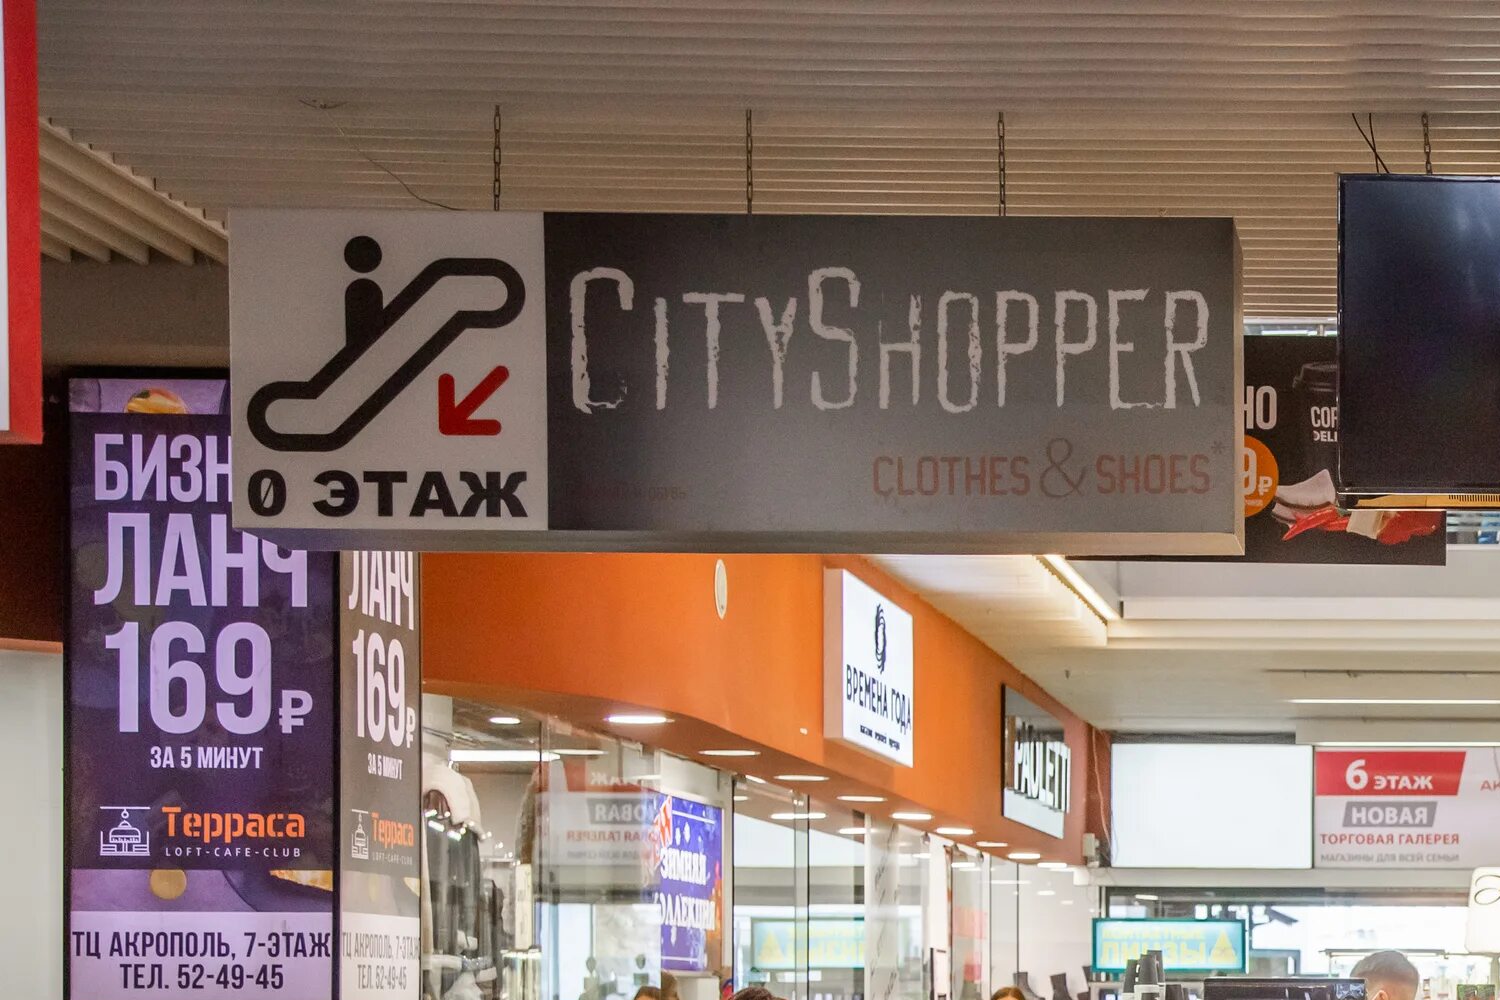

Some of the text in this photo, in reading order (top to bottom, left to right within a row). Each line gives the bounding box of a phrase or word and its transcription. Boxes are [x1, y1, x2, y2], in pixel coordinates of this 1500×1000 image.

[872, 455, 1030, 499] CLOTHES
[1038, 437, 1088, 500] &
[248, 470, 529, 517] 0 ЭТАЖ
[94, 512, 308, 607] ЛАНЧ
[846, 664, 911, 735] ВРЕМЕНА ГОДА
[150, 747, 264, 769] ЗА 5 МИНУТ
[1345, 759, 1434, 790] 6 ЭТАЖ
[162, 807, 305, 843] Терраса
[371, 812, 414, 849] Терраса
[1351, 807, 1428, 825] НОВАЯ
[165, 847, 302, 857] LOFT-CAFE-CLUB
[1320, 834, 1460, 845] ТОРГОВАЯ ГАЛЕРЕЯ
[1320, 853, 1374, 862] МАГАЗИНЫ
[72, 931, 331, 960] ТЦ АКРОПОЛЬ, 7-ЭТАЖ
[119, 963, 284, 990] ТЕЛ. 52-49-45
